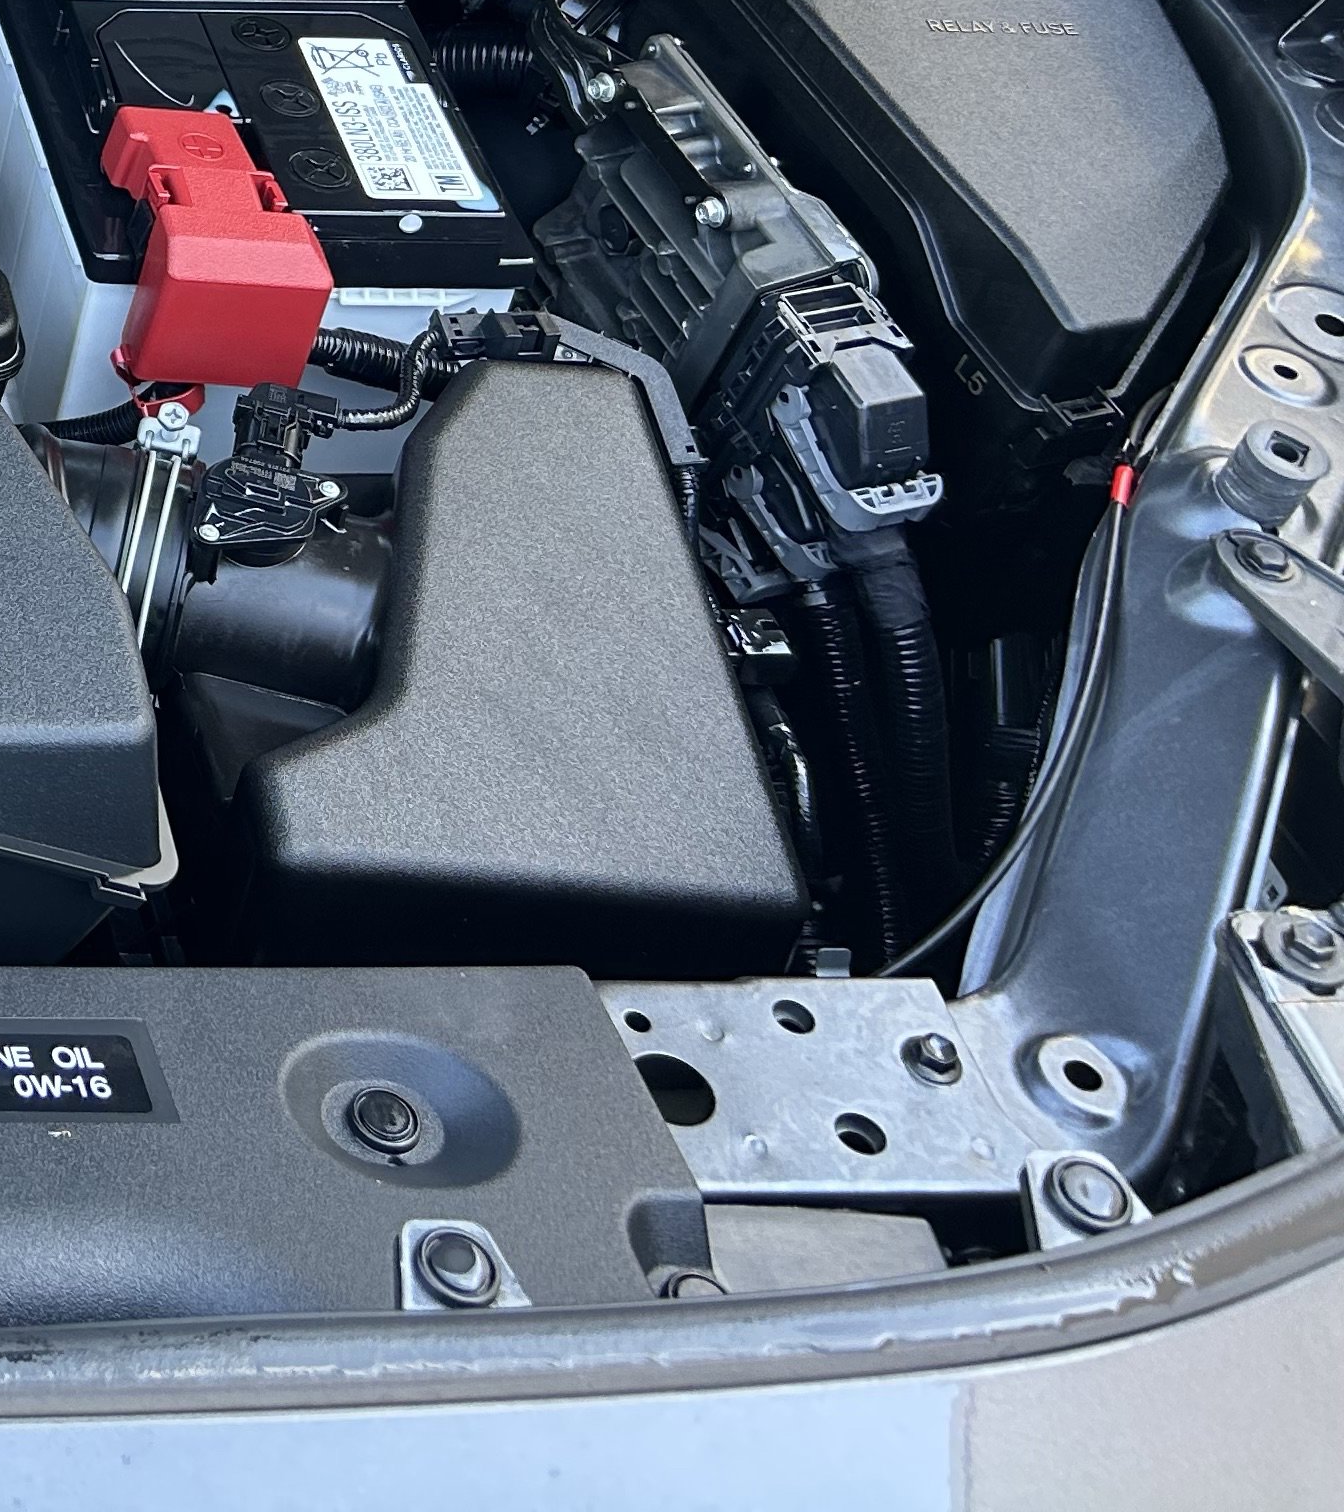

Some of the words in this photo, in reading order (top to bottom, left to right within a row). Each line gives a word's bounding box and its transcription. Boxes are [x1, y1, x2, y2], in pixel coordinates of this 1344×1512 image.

[925, 18, 994, 34] RELAY
[1000, 21, 1017, 34] &
[1018, 21, 1079, 36] FUSE
[375, 52, 391, 67] Pb
[332, 100, 383, 162] 380LN3-ISS
[434, 175, 468, 193] TM
[954, 353, 988, 396] L5
[51, 1045, 106, 1070] OIL
[13, 1074, 113, 1100] 0W-16
